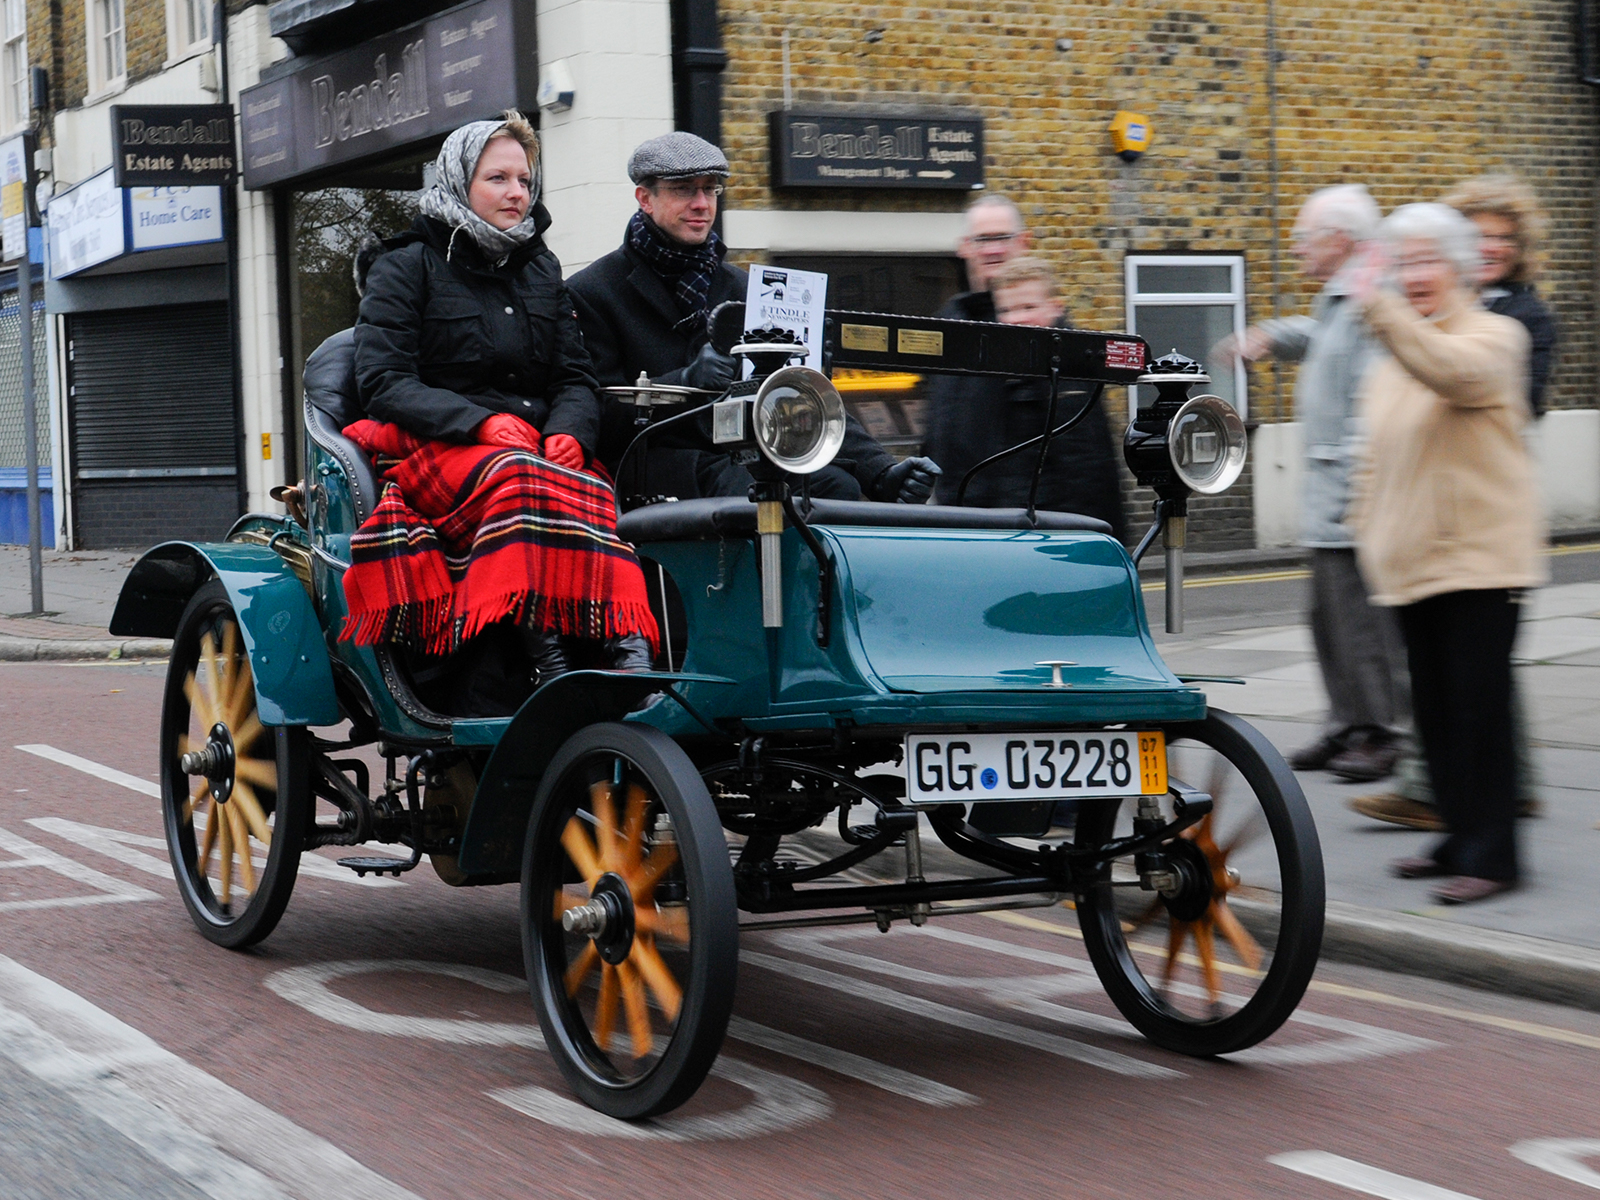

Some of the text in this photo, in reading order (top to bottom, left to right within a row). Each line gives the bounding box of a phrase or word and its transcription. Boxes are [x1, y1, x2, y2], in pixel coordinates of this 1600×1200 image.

[311, 38, 430, 150] Bendall
[121, 118, 231, 145] Bendall
[927, 127, 975, 143] Estate
[790, 122, 924, 161] Bendall
[125, 153, 233, 173] Estate Agents
[927, 146, 977, 165] Agents
[818, 165, 882, 179] Management
[140, 205, 213, 227] Home Care
[768, 306, 810, 319] TINDLE
[1141, 737, 1157, 752] 07
[916, 741, 974, 792] GG
[1006, 738, 1131, 790] 03228
[1143, 755, 1158, 769] 11
[1145, 772, 1159, 787] 11
